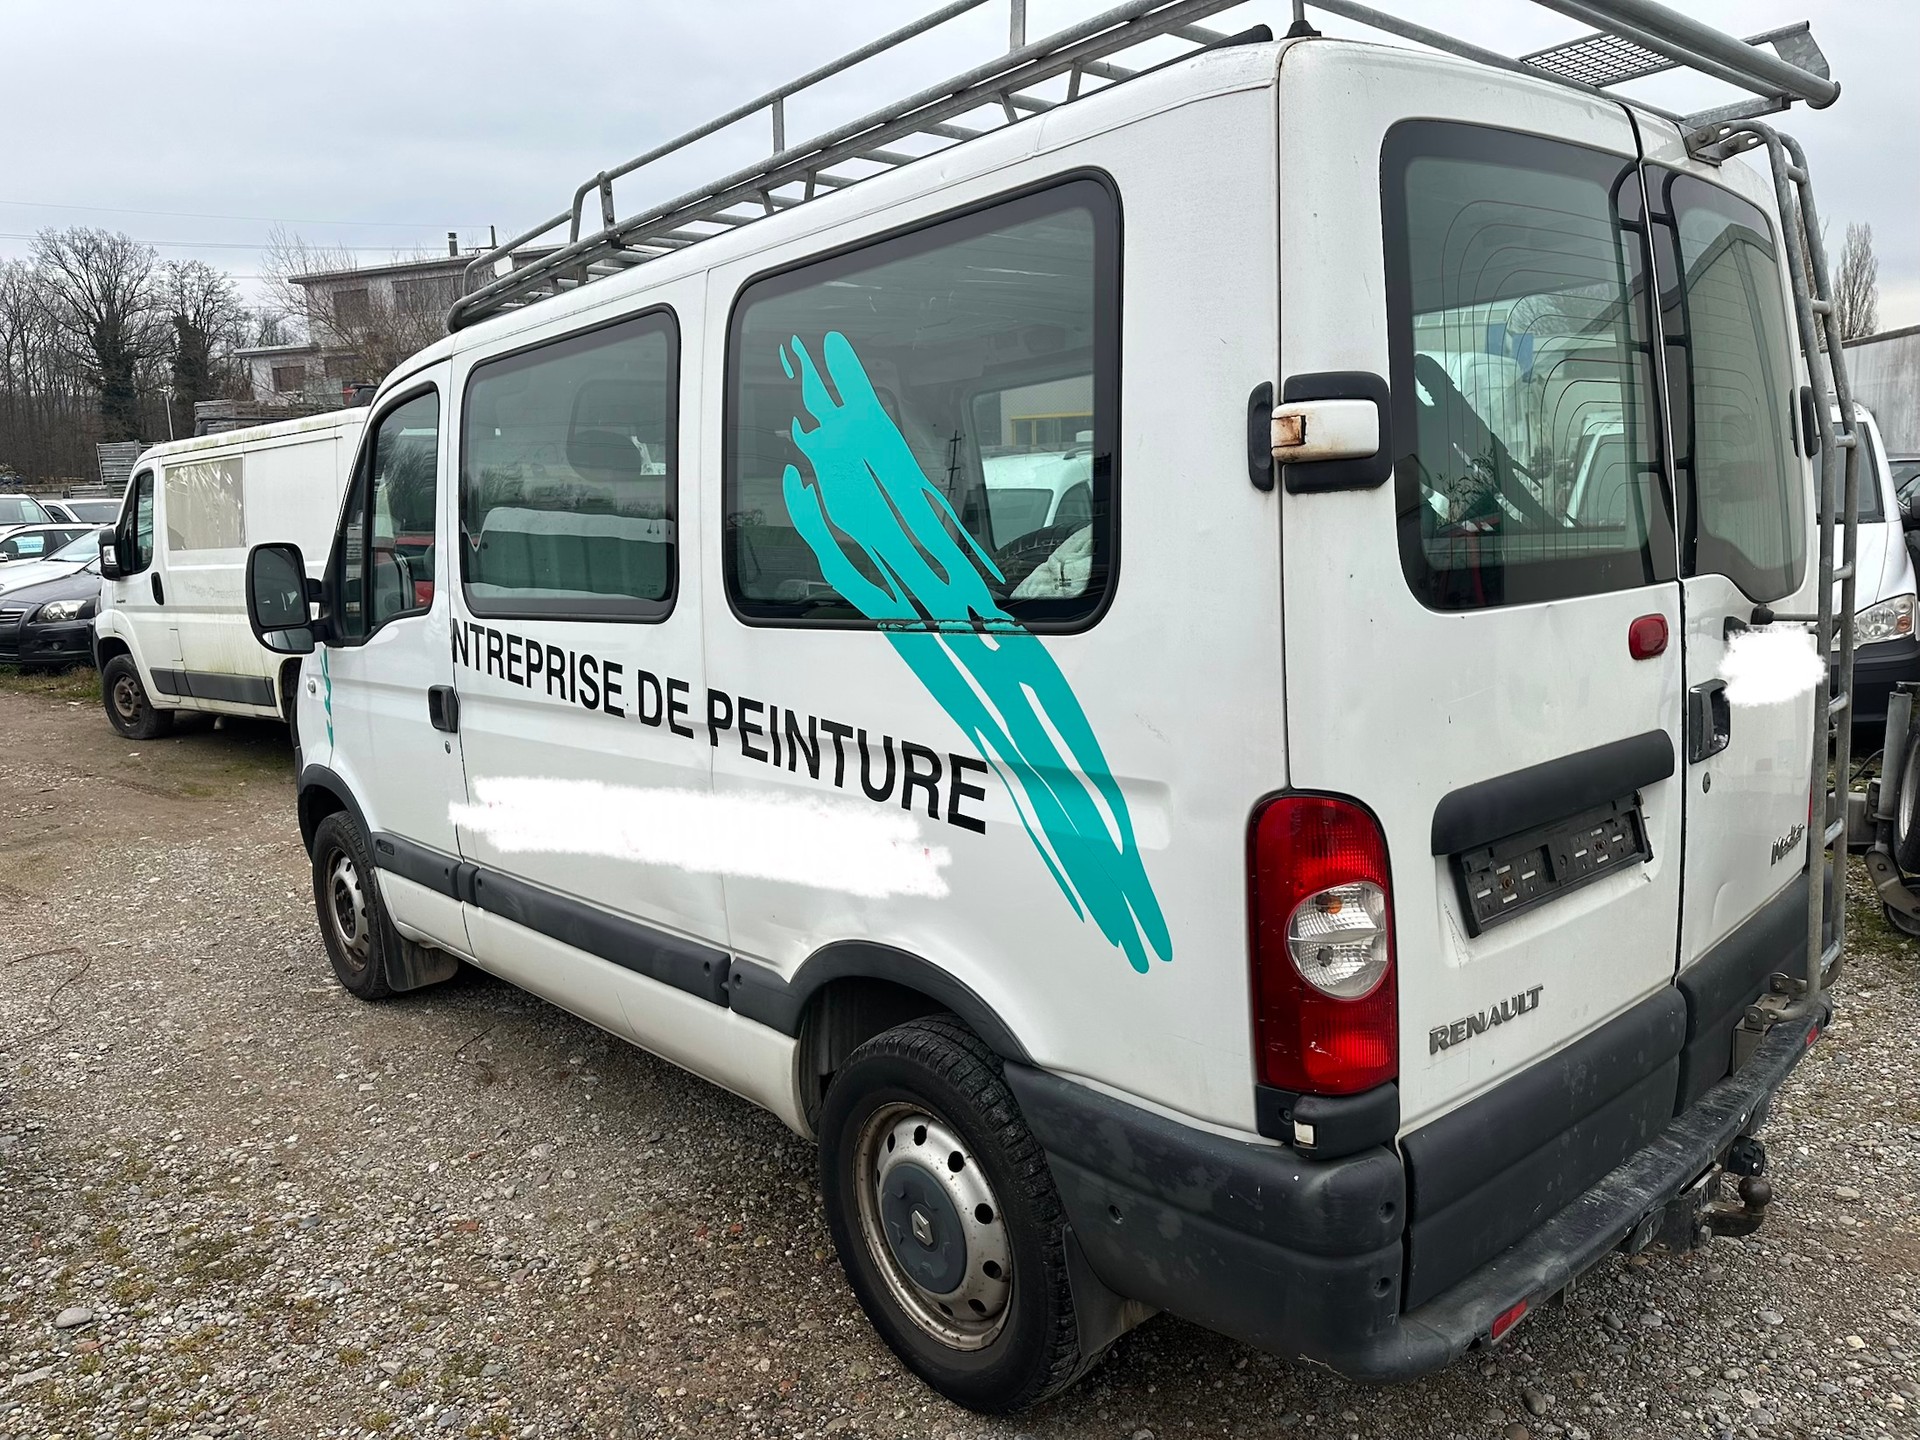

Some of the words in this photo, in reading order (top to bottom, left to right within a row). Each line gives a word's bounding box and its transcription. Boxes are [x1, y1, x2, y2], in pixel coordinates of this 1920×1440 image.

[638, 669, 694, 739] DE
[707, 688, 988, 835] PEINTURE
[1429, 983, 1544, 1055] RENAULT
